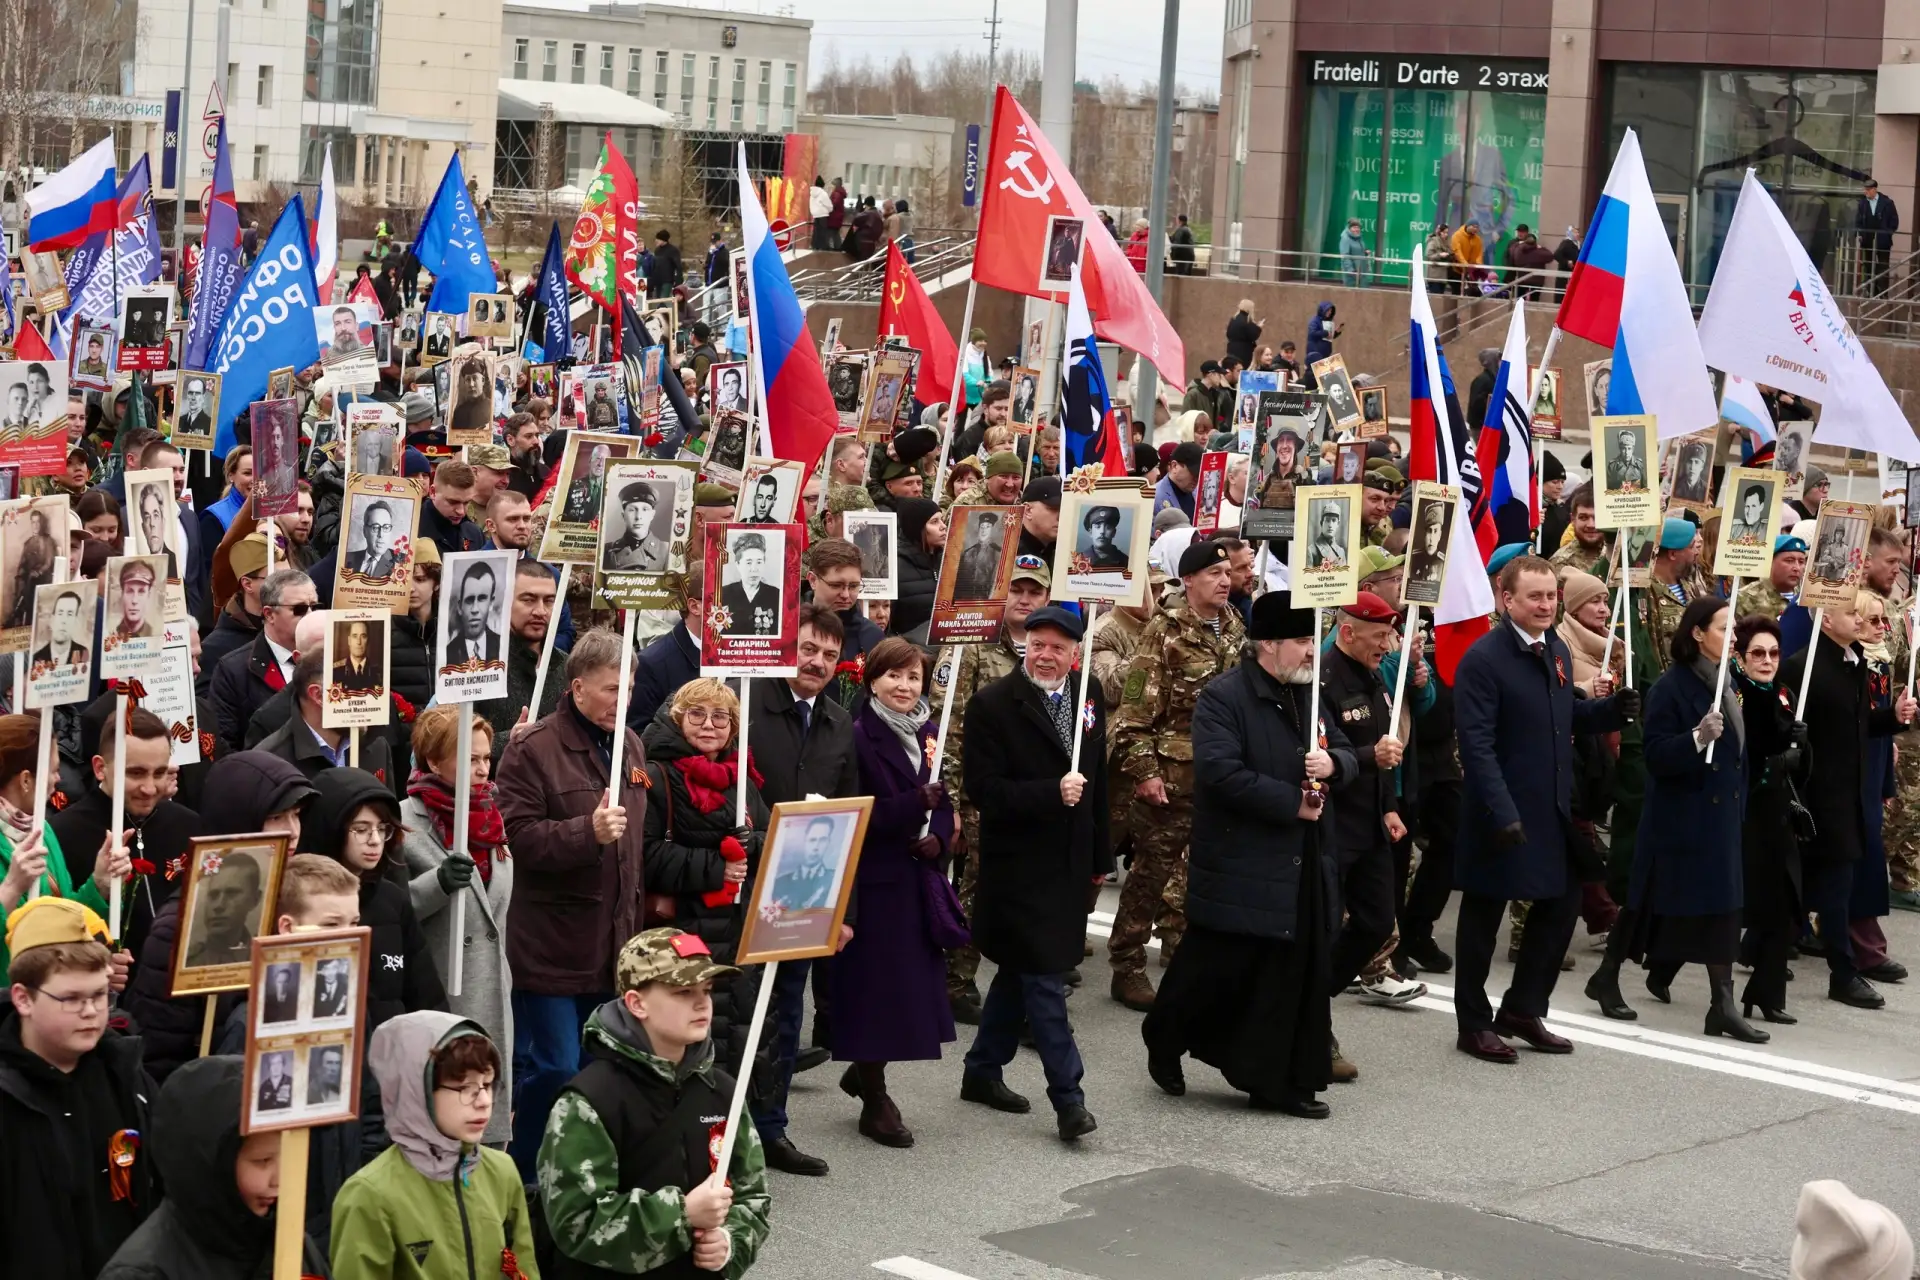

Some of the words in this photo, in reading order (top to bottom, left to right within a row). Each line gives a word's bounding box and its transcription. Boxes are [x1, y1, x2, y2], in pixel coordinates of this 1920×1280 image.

[1314, 60, 1379, 82] Fratelli
[1398, 63, 1460, 85] D'arte
[1479, 66, 1492, 86] 2
[1497, 72, 1549, 88] этаж
[64, 99, 163, 117] ФЛАРМОНИЯ
[1376, 128, 1424, 138] RBSON
[607, 576, 656, 586] РЯБЧИКОВ
[729, 640, 770, 648] САМАРИНА
